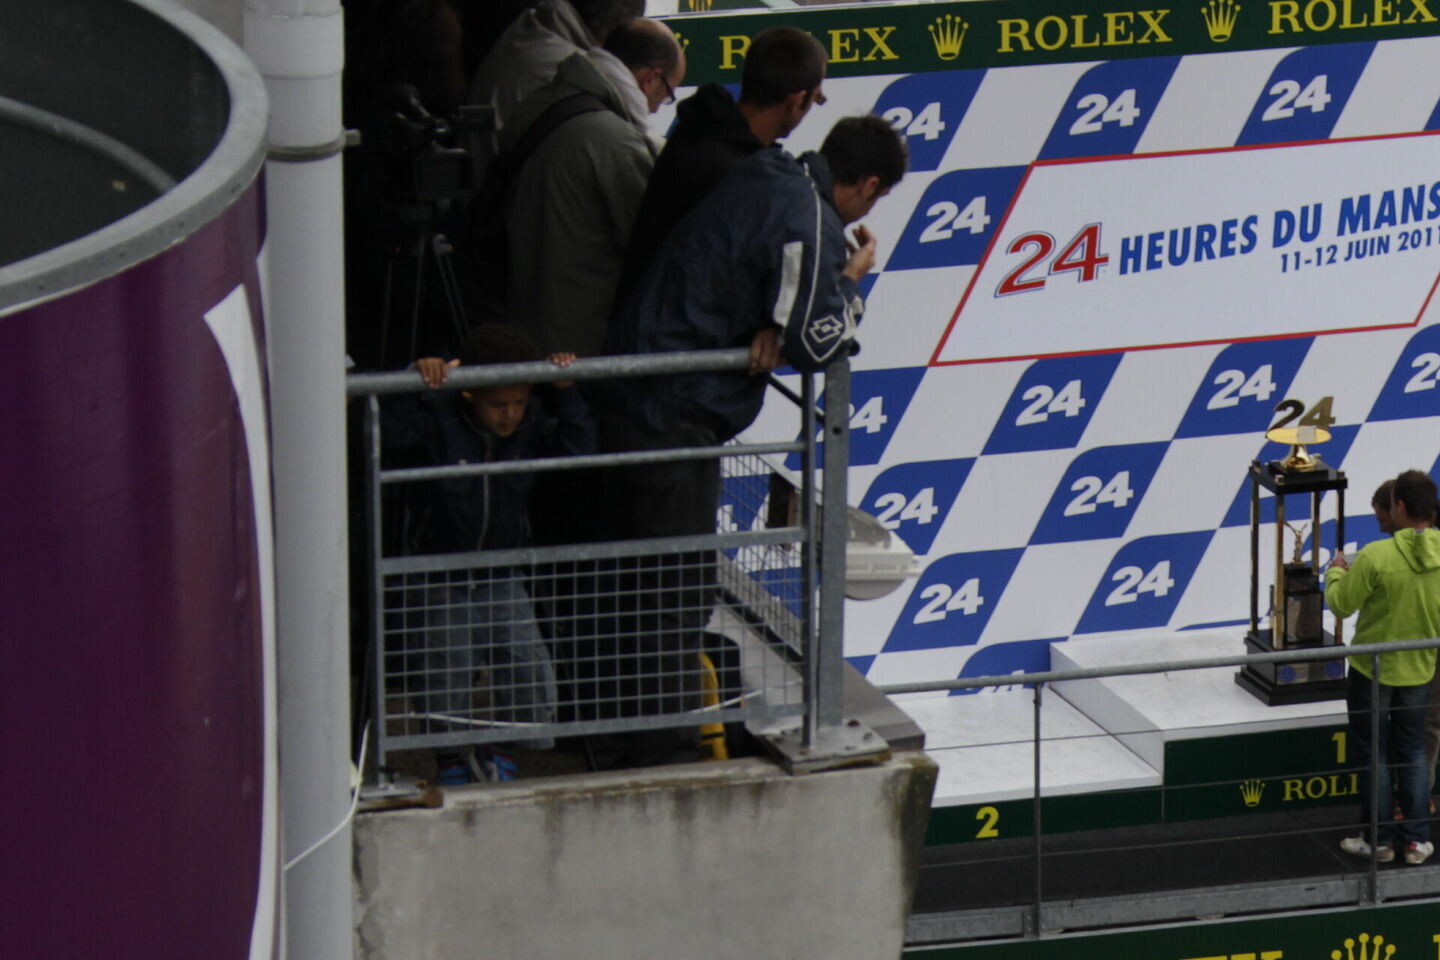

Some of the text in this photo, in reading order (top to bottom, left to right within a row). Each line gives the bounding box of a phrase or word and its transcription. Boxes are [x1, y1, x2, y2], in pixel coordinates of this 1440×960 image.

[998, 9, 1172, 53] ROLEX
[1267, 0, 1438, 35] ROLEX
[719, 26, 899, 69] REX
[1069, 89, 1140, 135] 24
[1261, 75, 1331, 121] 24
[919, 197, 990, 242] 24
[994, 221, 1108, 298] 24
[1118, 214, 1257, 275] HEURES
[1272, 203, 1322, 248] DU
[1281, 245, 1338, 273] 11-12
[1344, 235, 1390, 261] JUIN
[1015, 379, 1085, 425] 24
[1207, 364, 1276, 410] 24
[1265, 396, 1335, 438] 24
[874, 487, 938, 530] 24
[1063, 470, 1134, 516] 24
[913, 577, 983, 624] 24
[1105, 560, 1174, 607] 24
[1331, 731, 1347, 764] 1
[975, 806, 999, 839] 2
